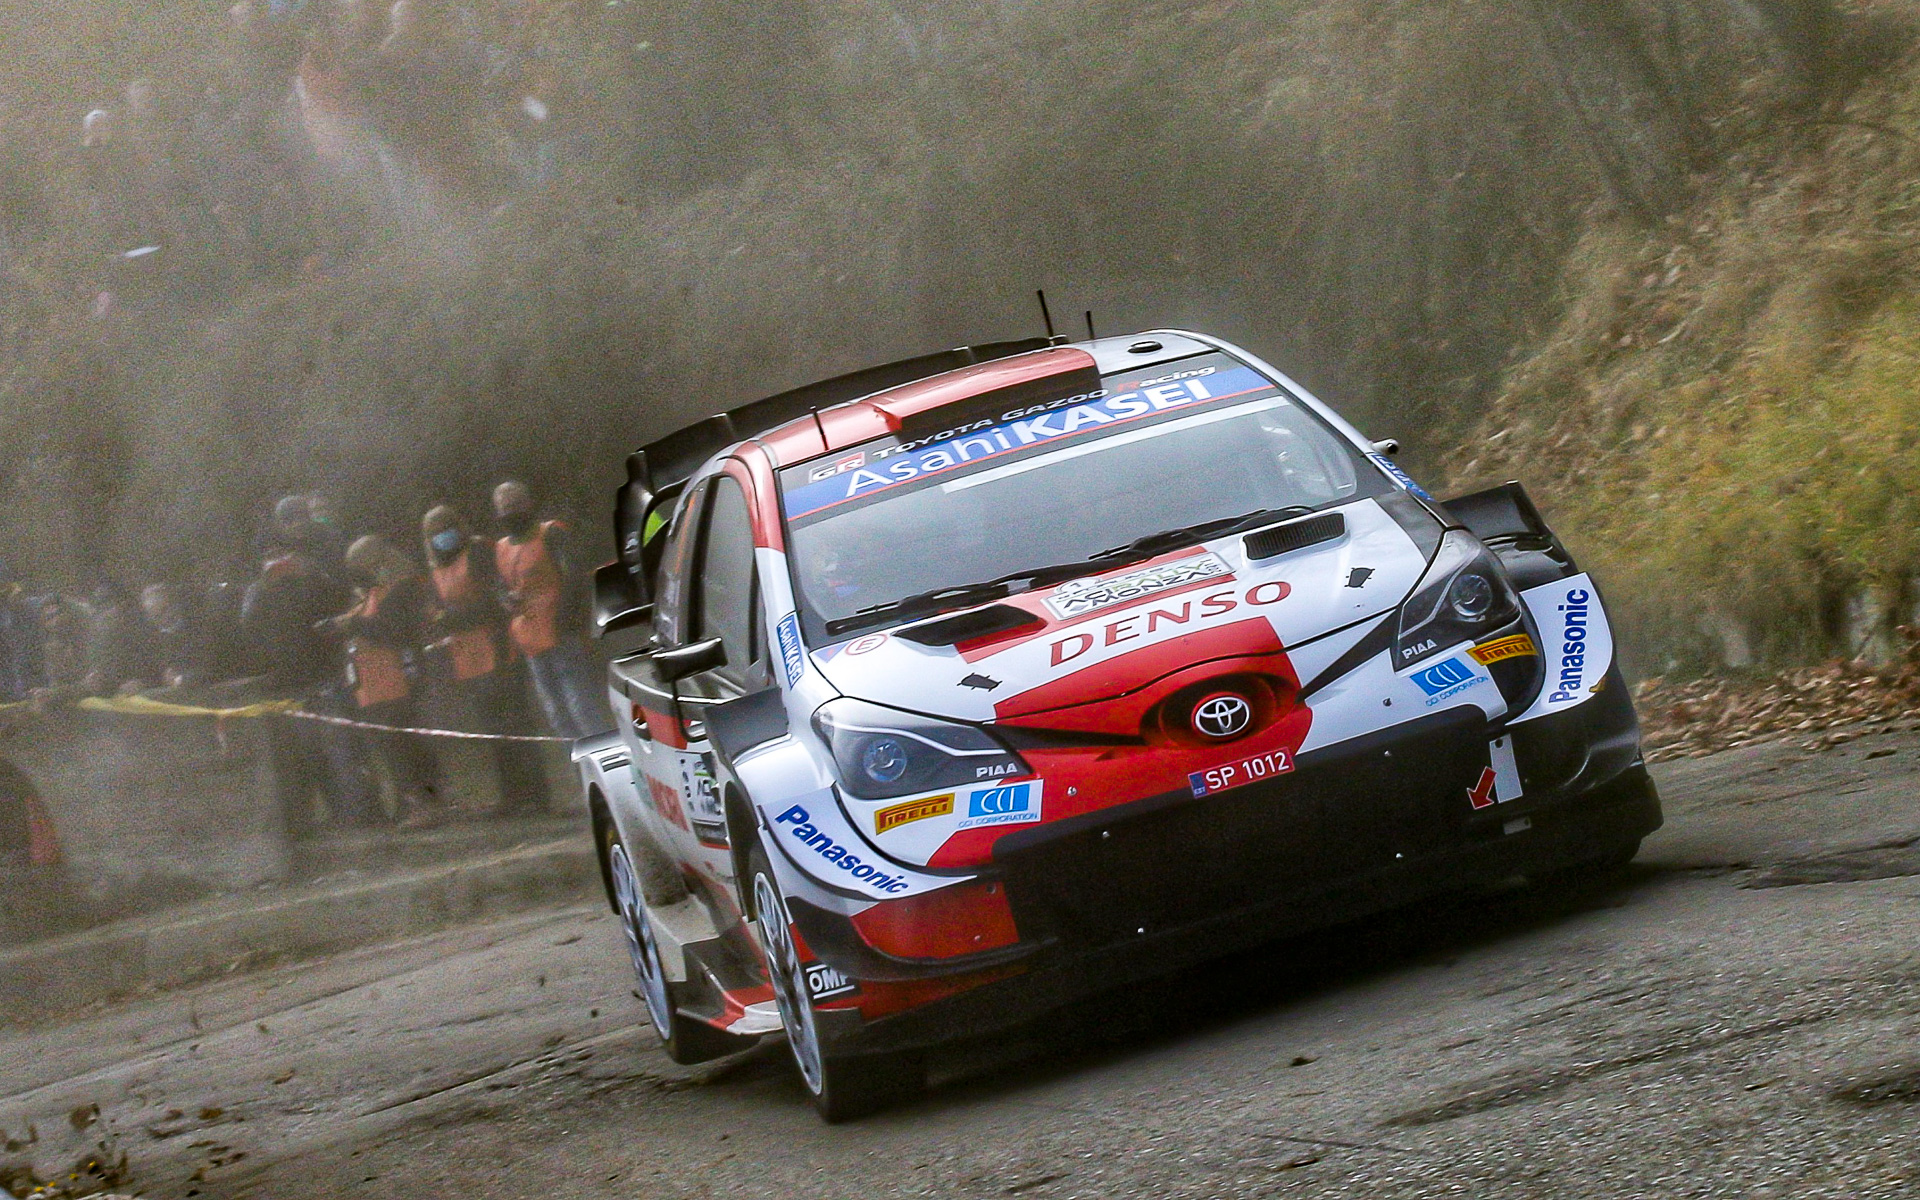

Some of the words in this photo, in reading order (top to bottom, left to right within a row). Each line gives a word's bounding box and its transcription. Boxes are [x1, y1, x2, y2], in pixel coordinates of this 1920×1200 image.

[811, 457, 864, 481] GR
[873, 418, 994, 458] TOYOTA
[1001, 389, 1109, 421] GAZOO
[1117, 366, 1216, 392] Racing
[1092, 571, 1212, 607] MONZA
[1050, 581, 1291, 667] DENSO
[1401, 639, 1438, 659] PIAA
[1474, 637, 1534, 662] PIRELLI
[1548, 589, 1589, 703] Panasonic
[976, 762, 1018, 778] PIAA
[1205, 766, 1235, 790] SP
[1242, 752, 1290, 779] 1012
[880, 797, 950, 829] PIRELLI
[981, 787, 1015, 813] CCI
[774, 803, 909, 893] Panasonic
